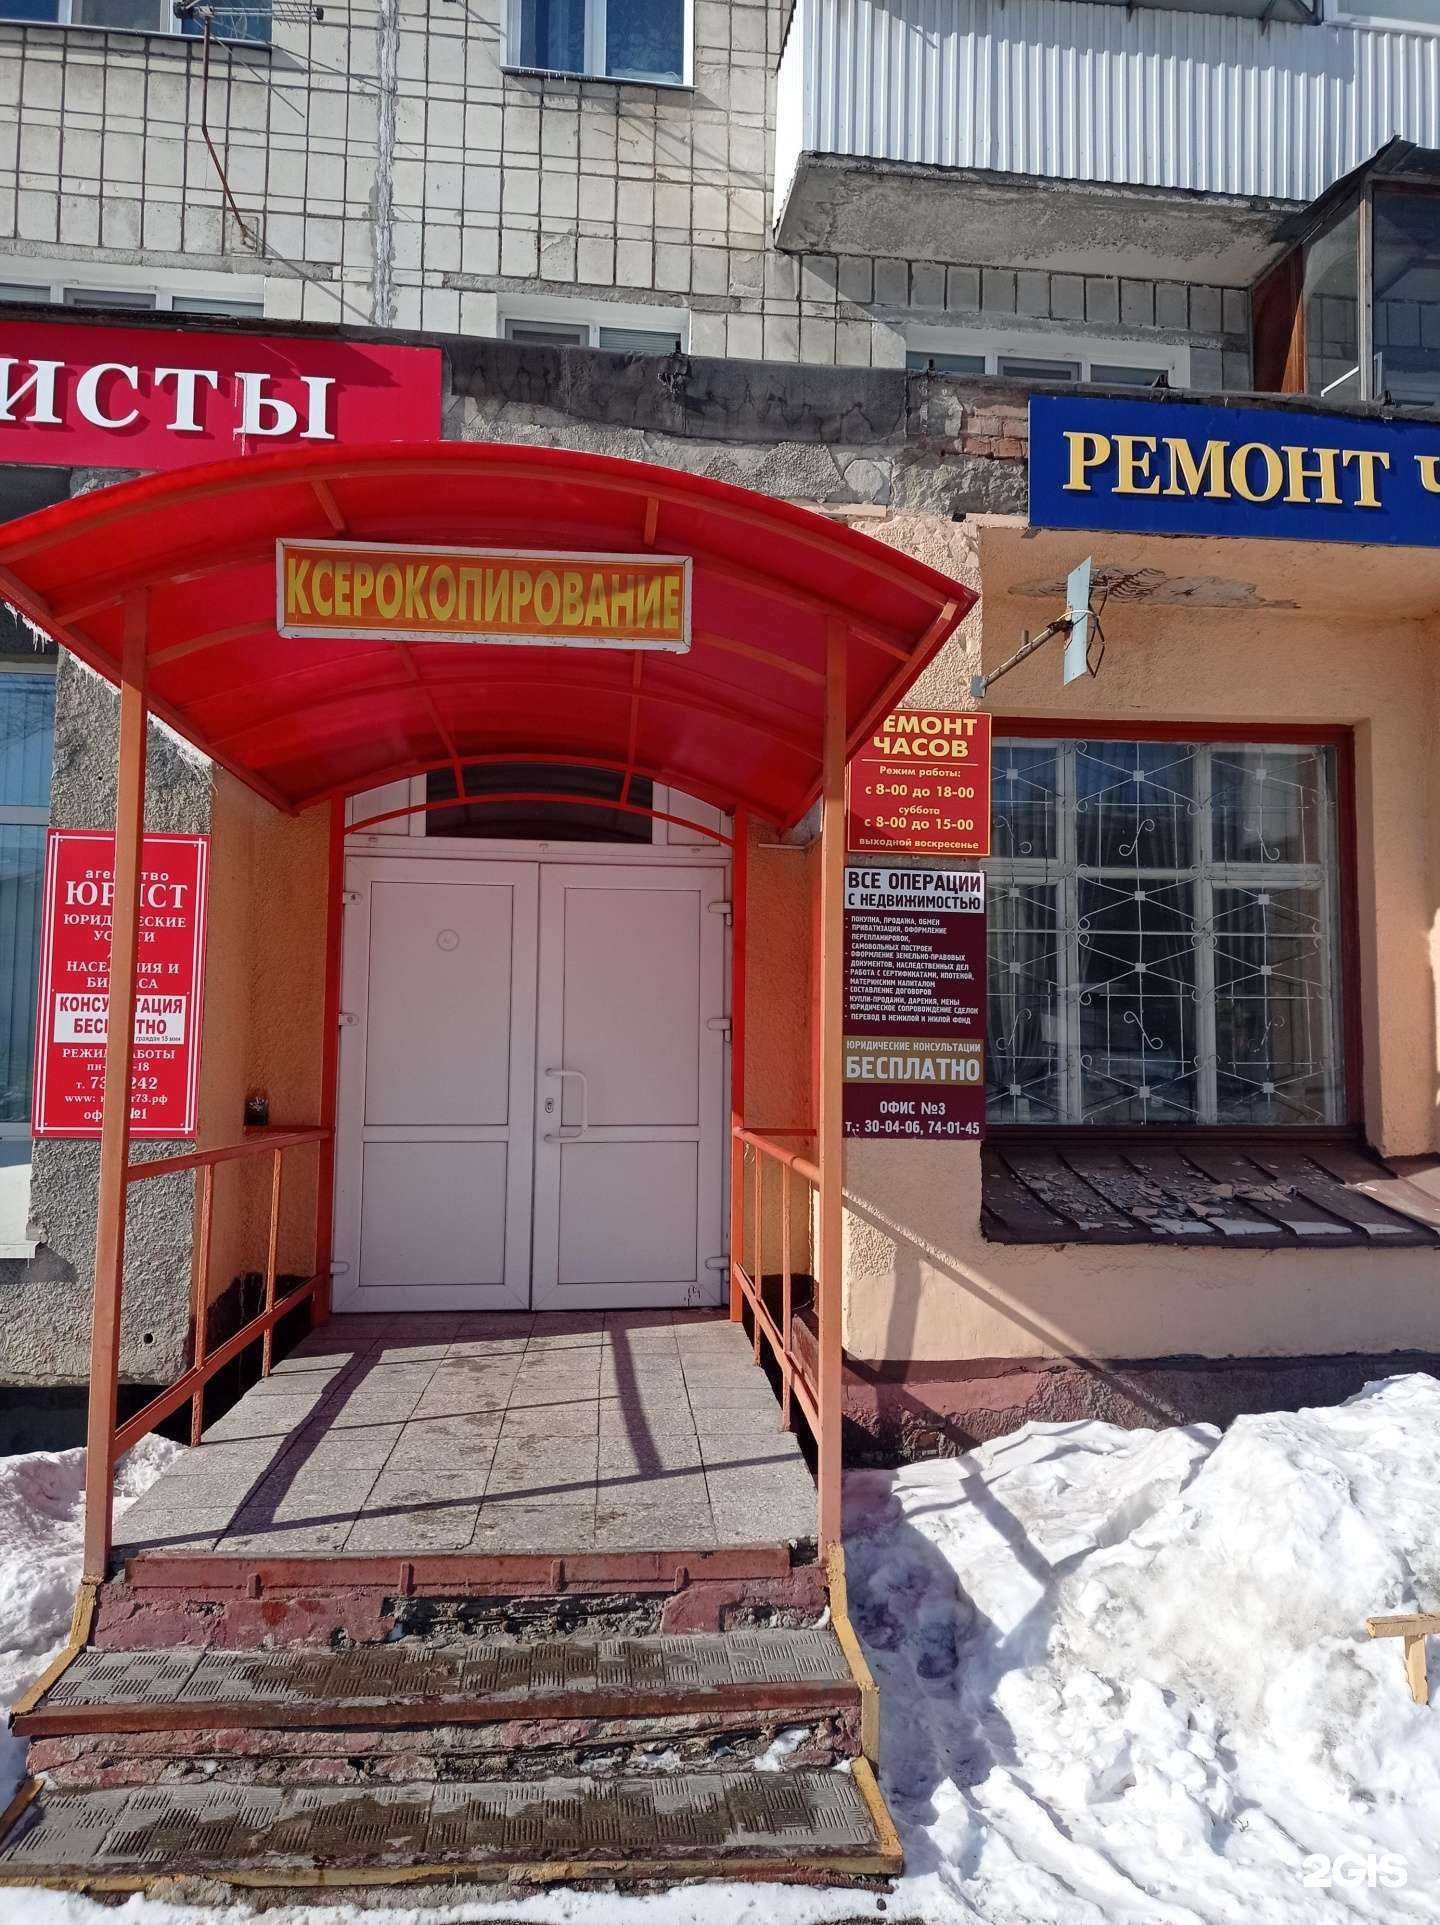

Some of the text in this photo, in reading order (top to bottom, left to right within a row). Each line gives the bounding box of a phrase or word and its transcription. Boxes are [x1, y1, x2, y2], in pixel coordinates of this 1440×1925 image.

[1062, 431, 1390, 507] РЕМОНТ
[287, 558, 680, 629] КСЕРОКОПИРОВАНИЕ
[883, 714, 978, 736] ЕМОНТ
[873, 736, 969, 758] ЧАСОВ
[880, 766, 961, 778] Режим работы:
[865, 784, 974, 798] с 8-00 до 18-00
[898, 805, 940, 815] суббота
[864, 816, 974, 831] с 8-00 до 15-00
[860, 838, 979, 850] выходной воскресенье
[848, 871, 981, 894] ВСЕ ОПЕРАЦИИ
[65, 880, 188, 908] ЮРСТ
[848, 893, 980, 910] С НЕДВИЖИМОСТЬЮ
[851, 916, 882, 924] ПОКУПКА,
[884, 917, 917, 925] ПРОДАЖА,
[851, 924, 903, 933] ПРИВАТИЗАЦИЯ,
[851, 943, 900, 951] САМОВОЛЬНЫХ
[850, 951, 894, 959] ОФОРМЛЕНИЕ
[168, 964, 179, 974] И
[896, 962, 954, 970] НАСЛЕДСТВЕННЫХ
[850, 986, 932, 996] СОСТАВЛЕНИЕ ДОГОВОРОВ
[850, 1004, 896, 1012] ЮРИДИЧЕСКОЕ
[850, 1013, 880, 1021] ПЕРЕВОД
[74, 1018, 167, 1034] БЕСТНО
[62, 1048, 107, 1058] РЕЖИ
[846, 1040, 981, 1054] ЮРИДИЧЕСКИЕ КОНСУЛЬТАЦИИ
[846, 1056, 980, 1082] БЕСПЛАТНО
[880, 1101, 946, 1115] ОФИС №3
[864, 1120, 924, 1136] 30-04-06,
[928, 1120, 980, 1134] 74-01-45
